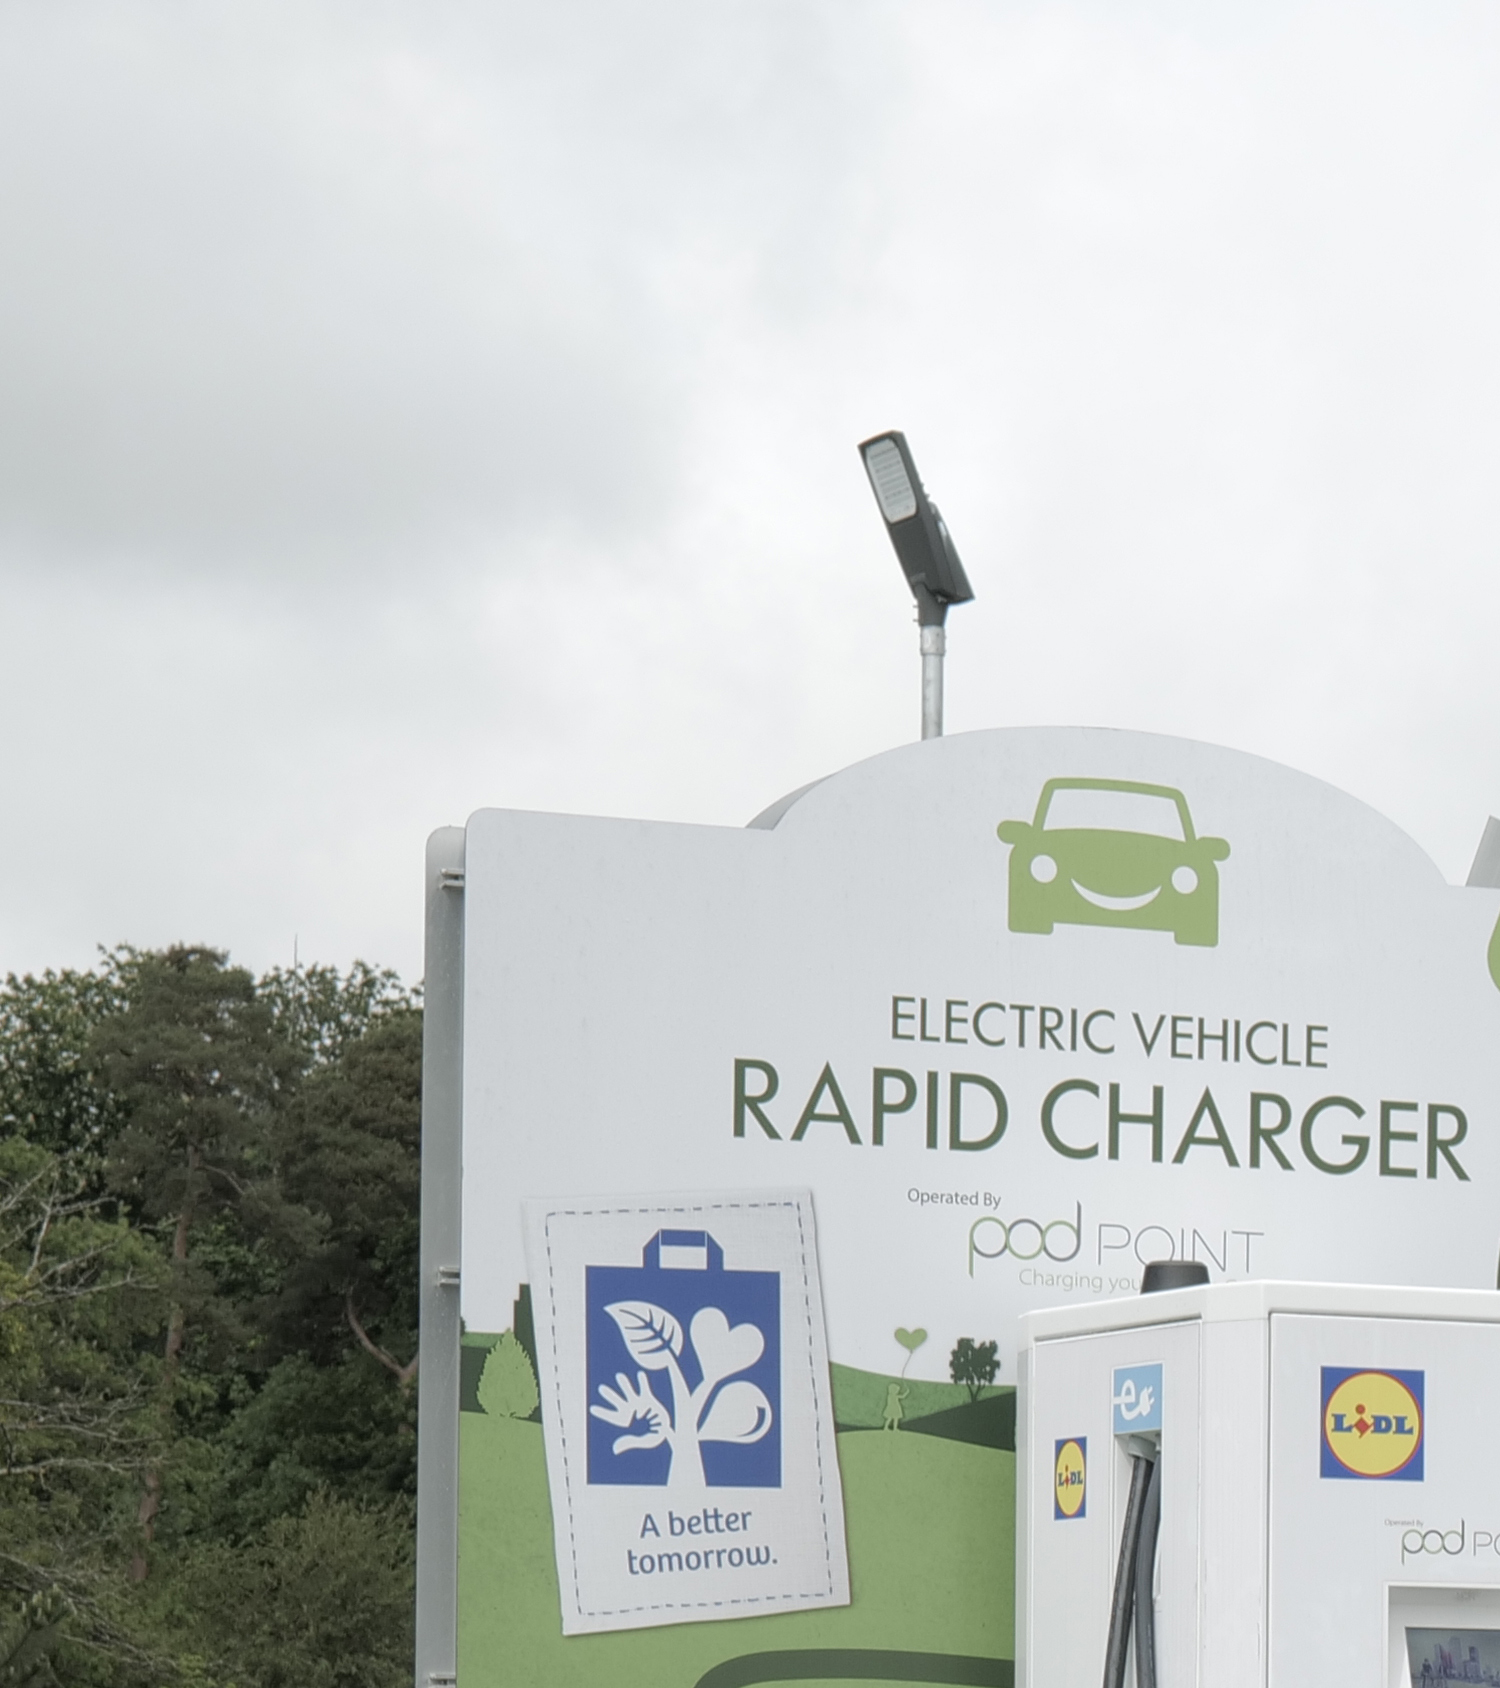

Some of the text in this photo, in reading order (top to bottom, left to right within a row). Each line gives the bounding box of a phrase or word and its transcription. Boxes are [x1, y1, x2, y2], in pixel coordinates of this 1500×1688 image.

[891, 996, 1329, 1069] ELECTRIC VEHICLE
[732, 1057, 1471, 1182] RAPID CHARGER
[907, 1188, 1002, 1210] Operated By
[968, 1200, 1265, 1279] pod POINT
[1018, 1268, 1144, 1293] Charging you
[640, 1507, 752, 1539] A better
[1401, 1517, 1465, 1565] pod
[627, 1545, 778, 1575] tomorrow.
